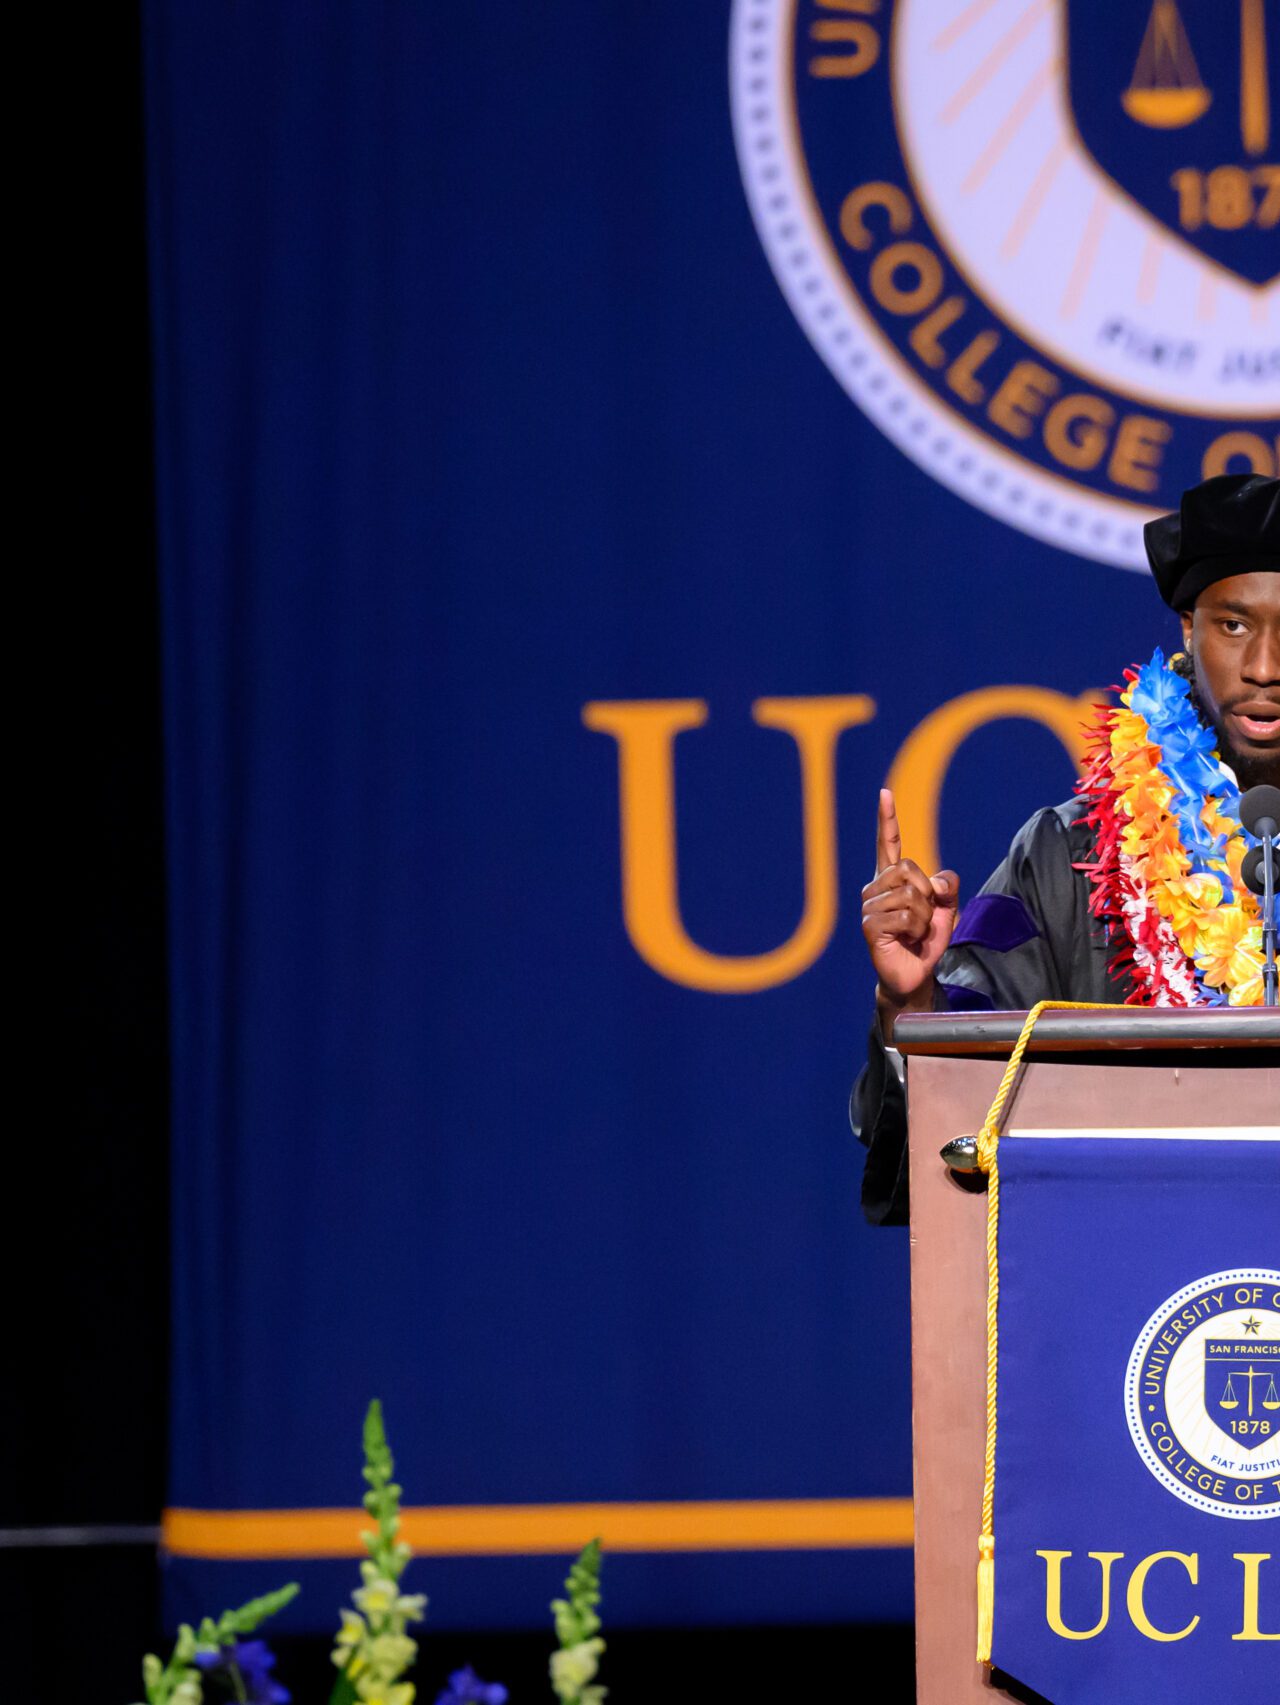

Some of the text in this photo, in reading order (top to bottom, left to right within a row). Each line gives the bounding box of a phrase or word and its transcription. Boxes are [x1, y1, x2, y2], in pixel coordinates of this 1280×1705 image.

[839, 181, 1172, 492] COLLEGE
[1144, 1291, 1224, 1395] UNIVERSITY
[1235, 1288, 1263, 1304] OF
[1209, 1345, 1231, 1354] SAN
[1150, 1421, 1227, 1496] COLLEGE
[1235, 1484, 1264, 1500] OF
[1210, 1454, 1235, 1470] FIAT
[1230, 1420, 1270, 1434] 1878
[1036, 1549, 1200, 1642] UC
